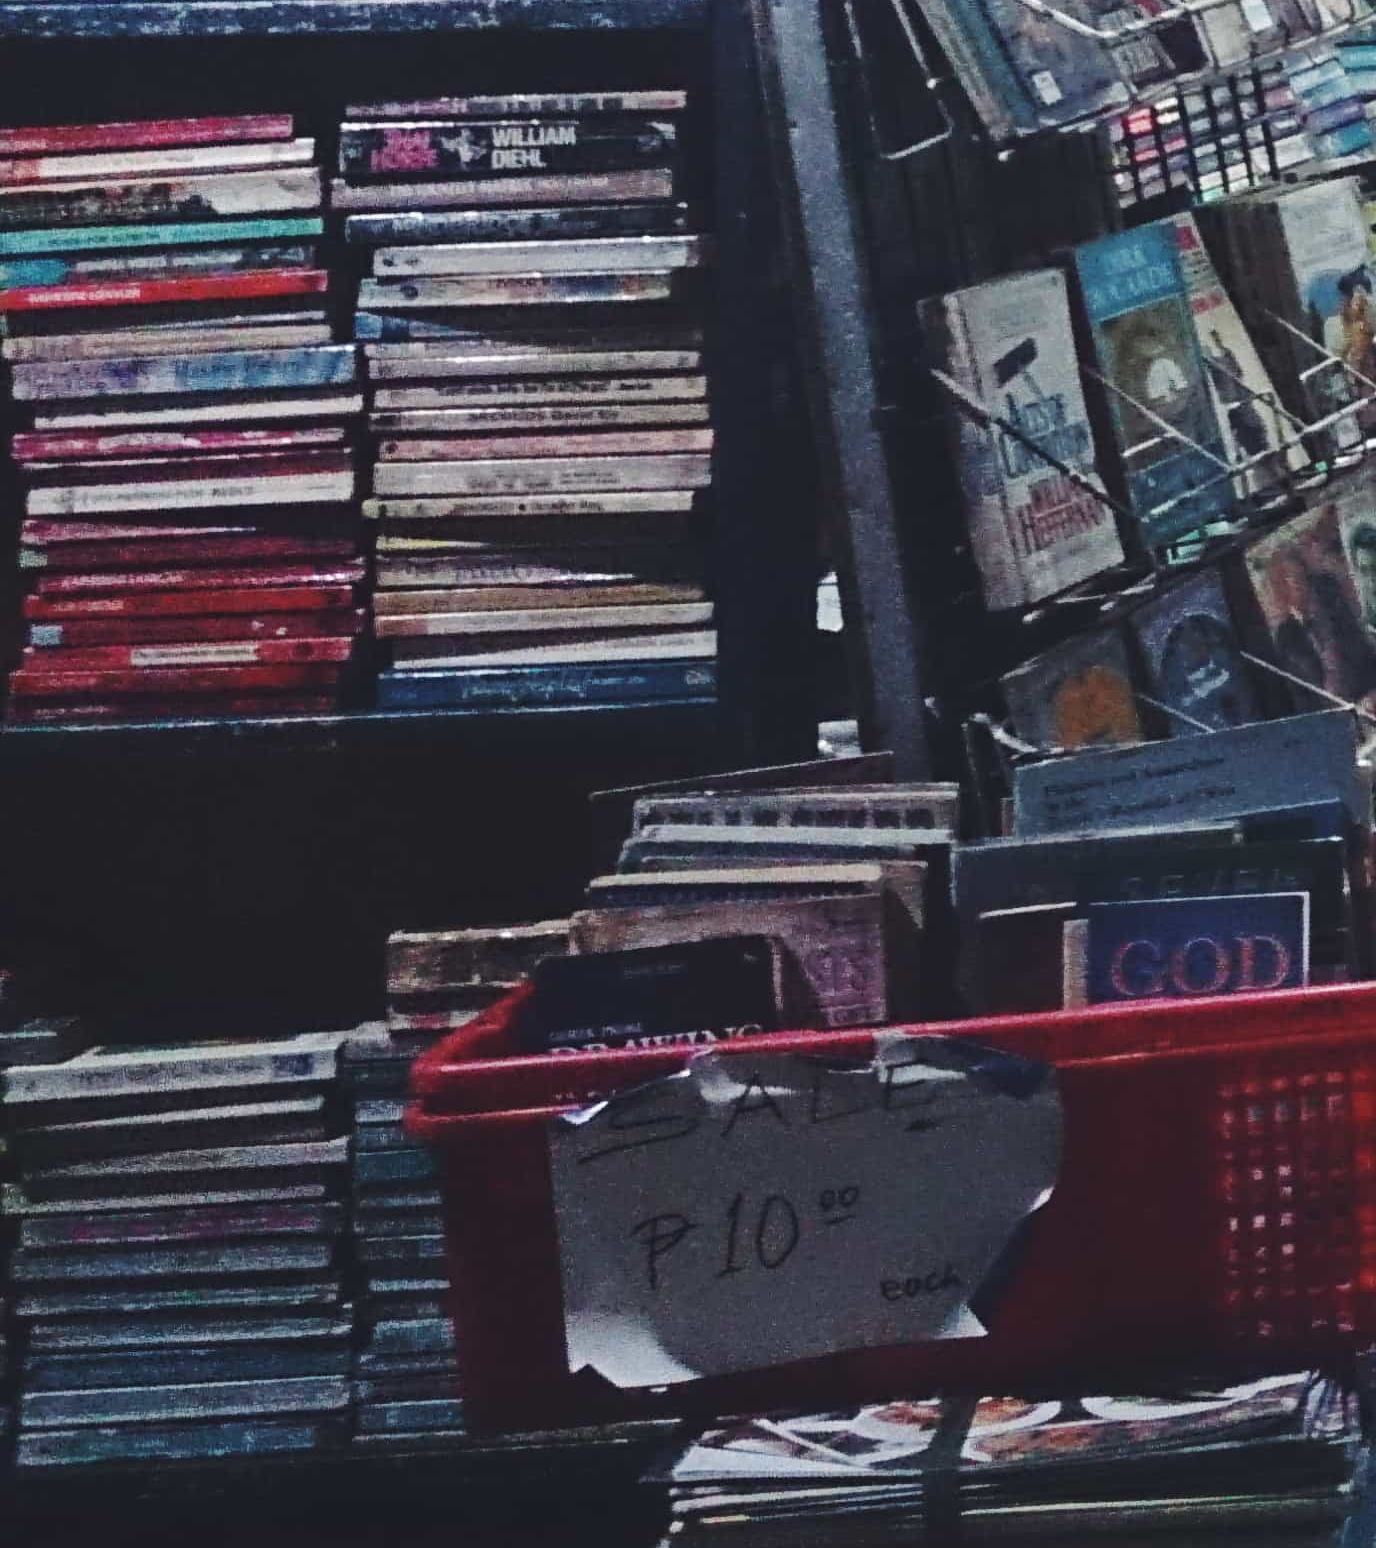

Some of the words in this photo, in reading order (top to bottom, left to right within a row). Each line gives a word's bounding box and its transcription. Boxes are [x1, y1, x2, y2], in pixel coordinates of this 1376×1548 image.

[491, 126, 578, 147] WILLIAM
[490, 149, 547, 170] DIEHL
[1112, 933, 1290, 997] GOD
[577, 1058, 936, 1164] SALE
[877, 1263, 963, 1303] each
